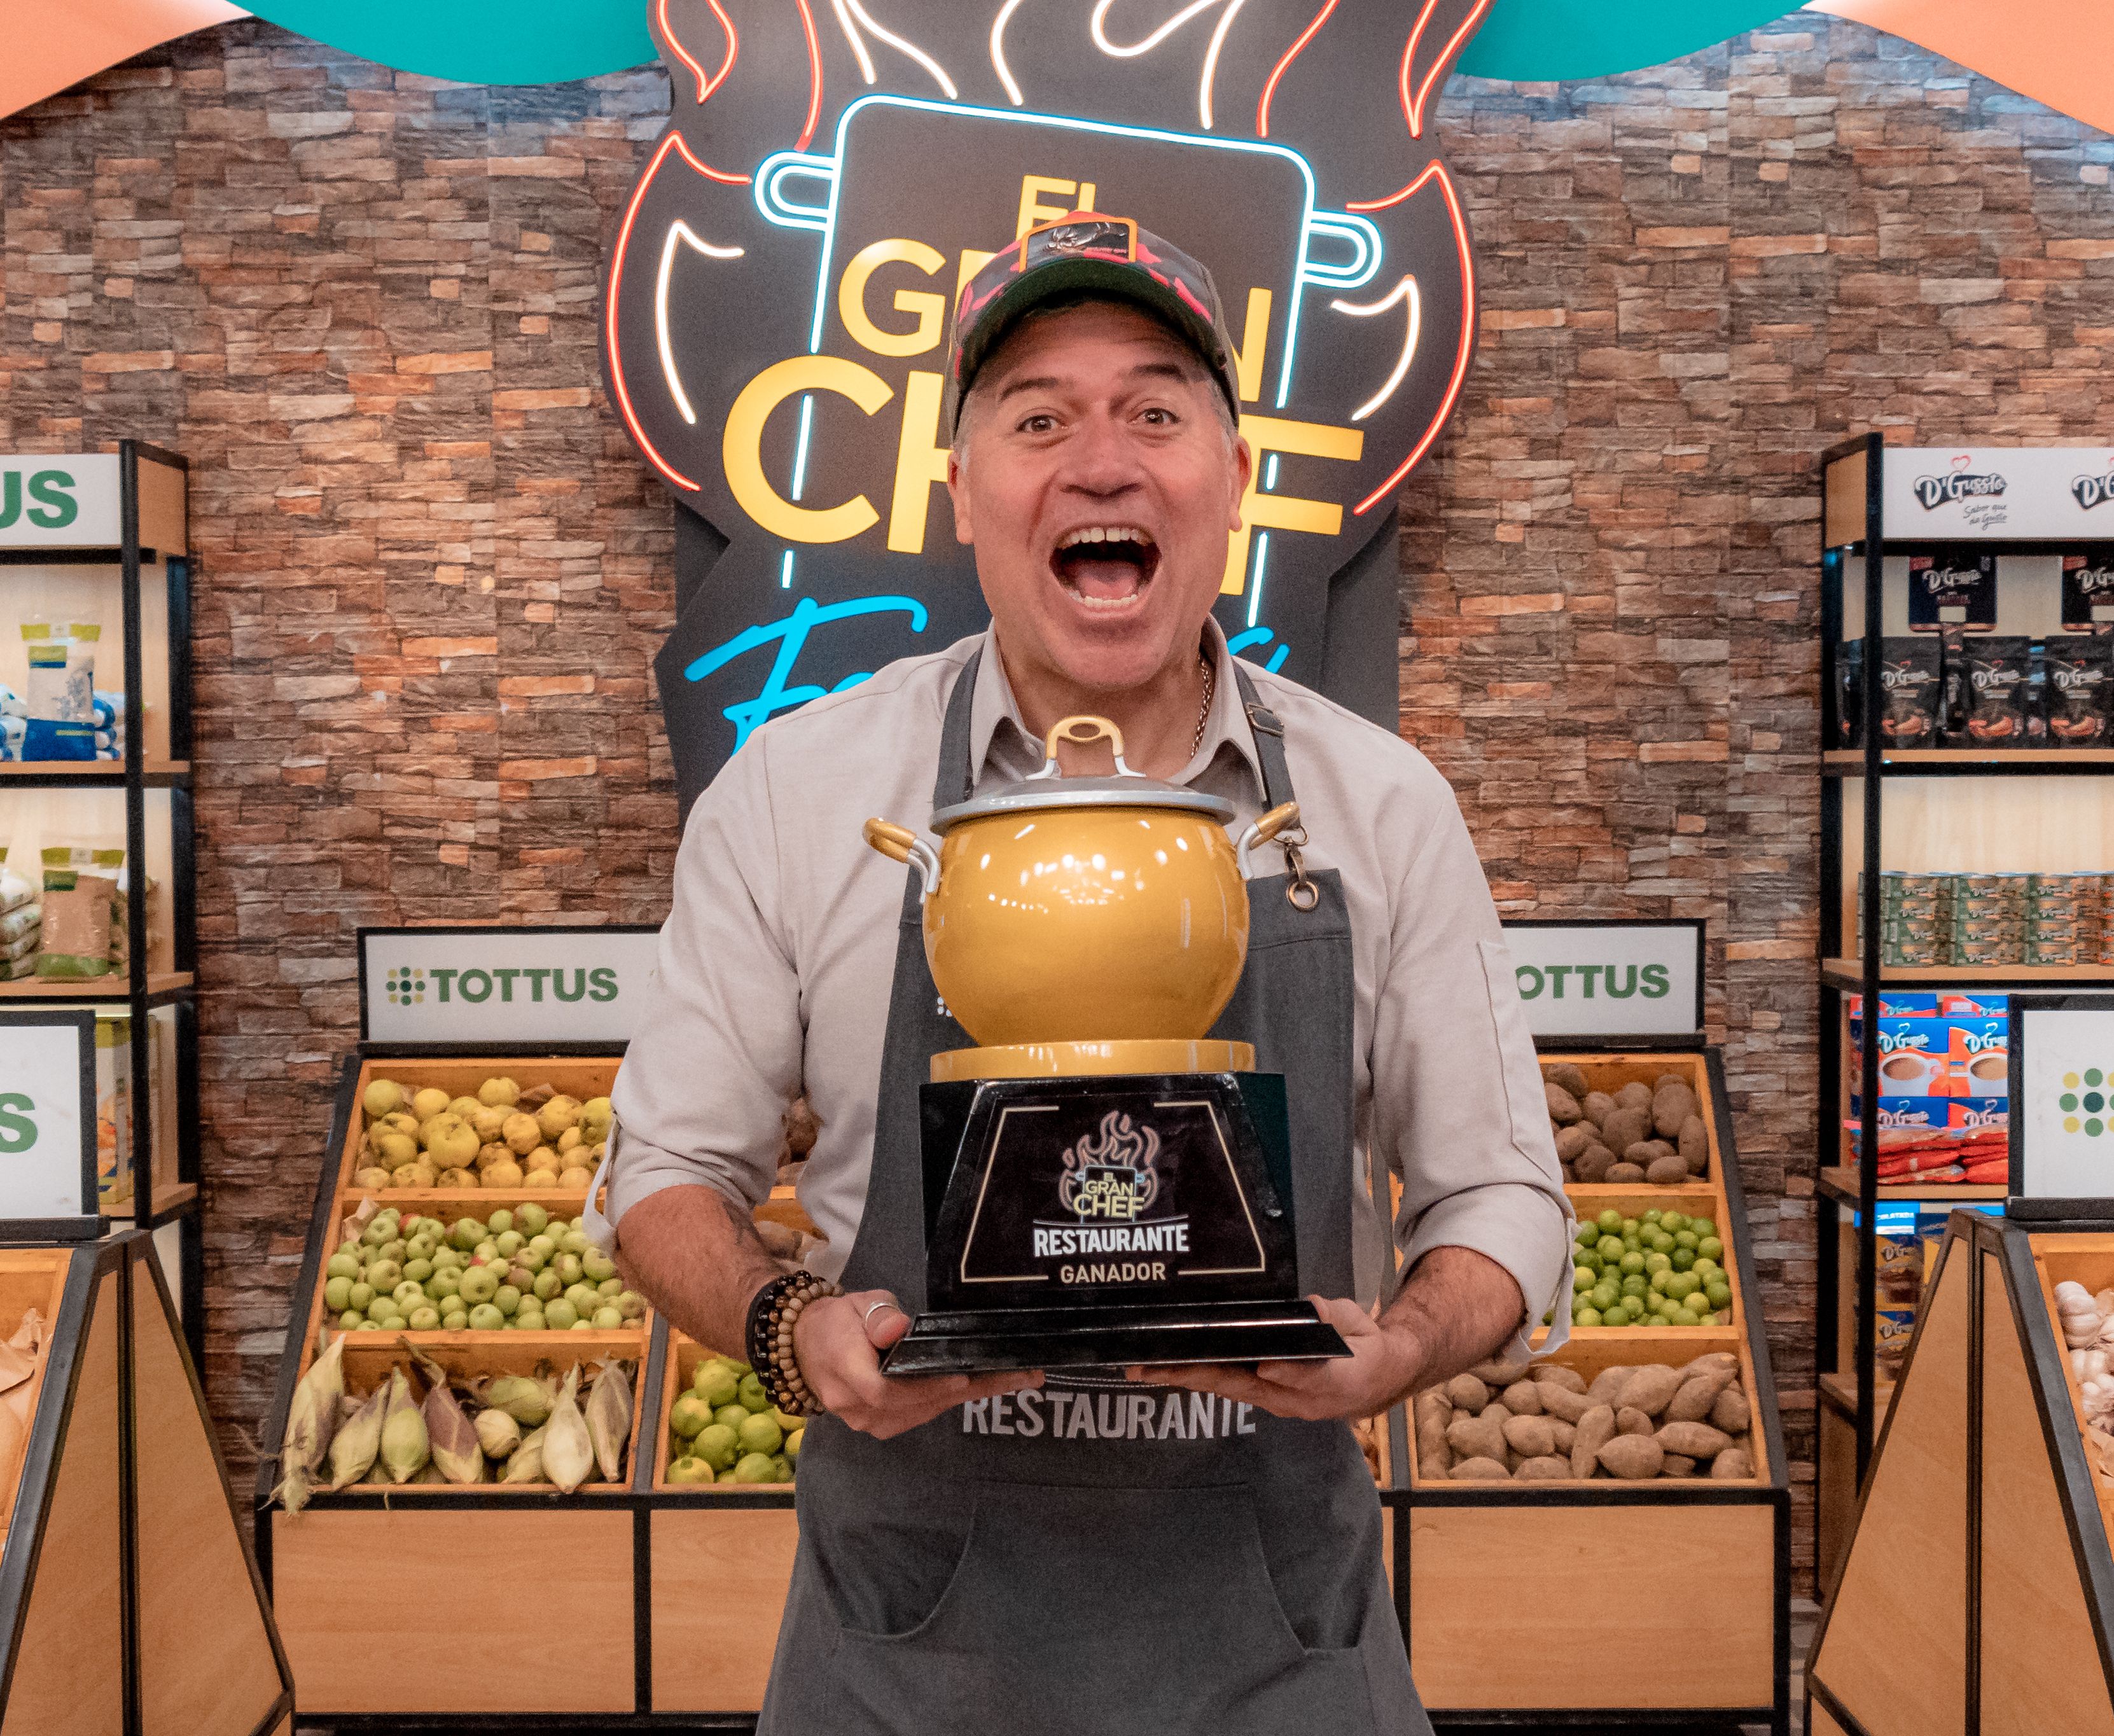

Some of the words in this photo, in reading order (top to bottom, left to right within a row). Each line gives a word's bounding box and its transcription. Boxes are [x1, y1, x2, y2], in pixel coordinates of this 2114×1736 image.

[429, 967, 619, 1003] TOTTUS
[1085, 1180, 1134, 1196] GRAN
[1073, 1193, 1145, 1218] CHEF
[1034, 1223, 1190, 1258] RESTAURANTE
[1060, 1261, 1166, 1284] GANADOR
